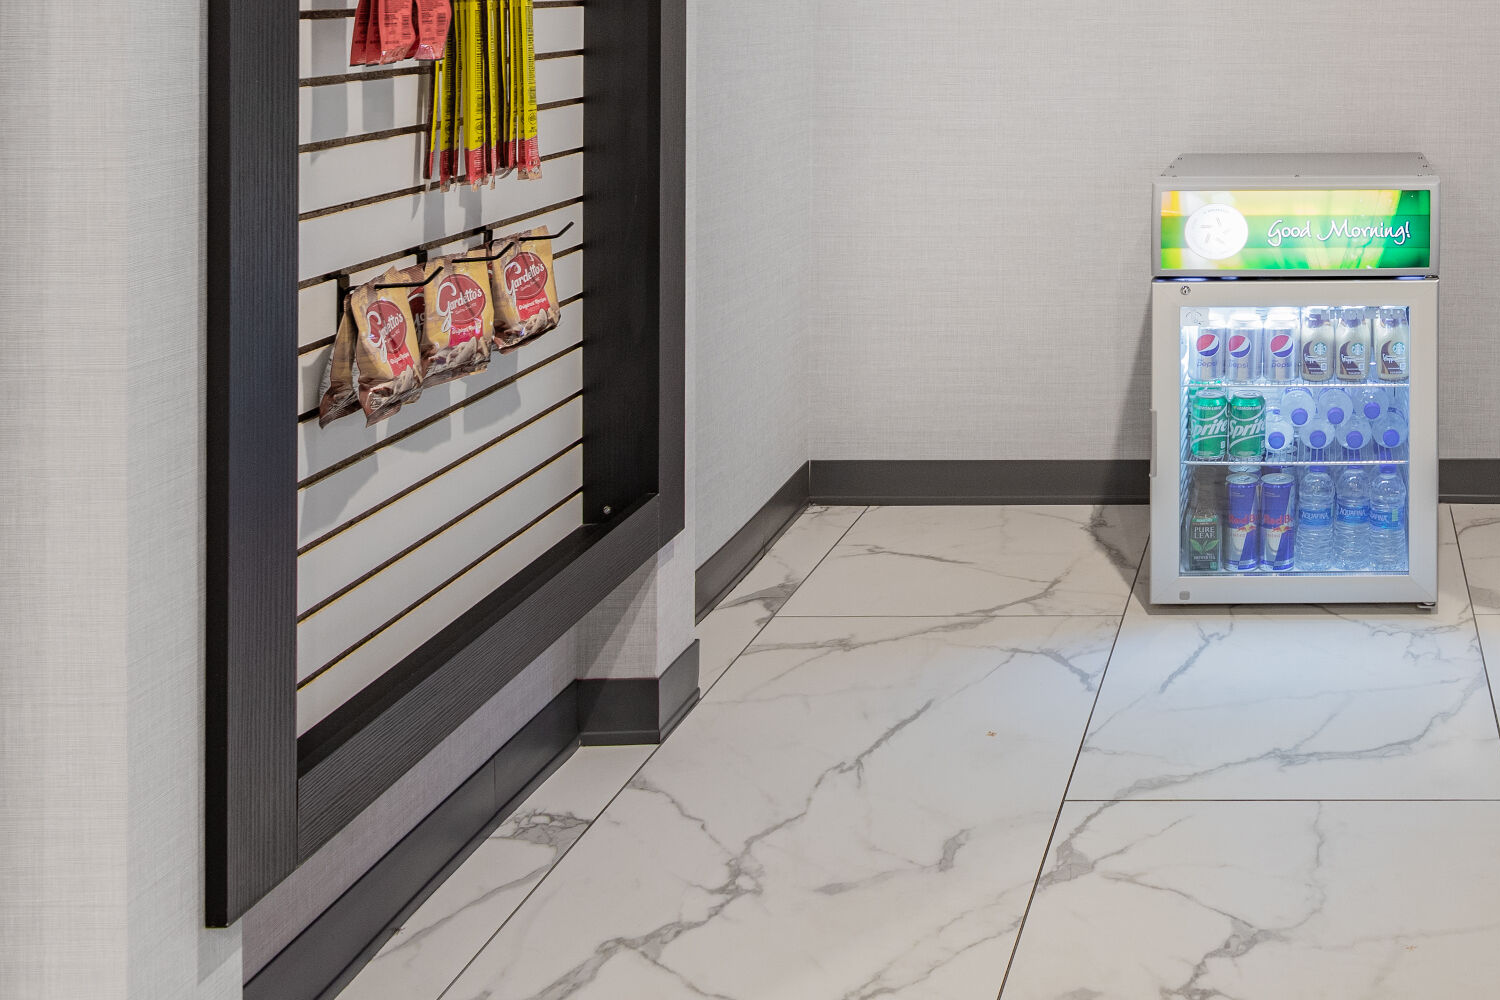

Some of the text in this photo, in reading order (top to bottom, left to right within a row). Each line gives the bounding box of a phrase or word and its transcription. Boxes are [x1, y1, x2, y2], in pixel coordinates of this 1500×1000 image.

[1268, 220, 1411, 247] Good Morning!
[503, 261, 546, 308] Gardetto's
[436, 281, 482, 333] Gardetto's
[1301, 511, 1330, 520] AQUAFINA
[1339, 507, 1367, 517] AQUAFINA
